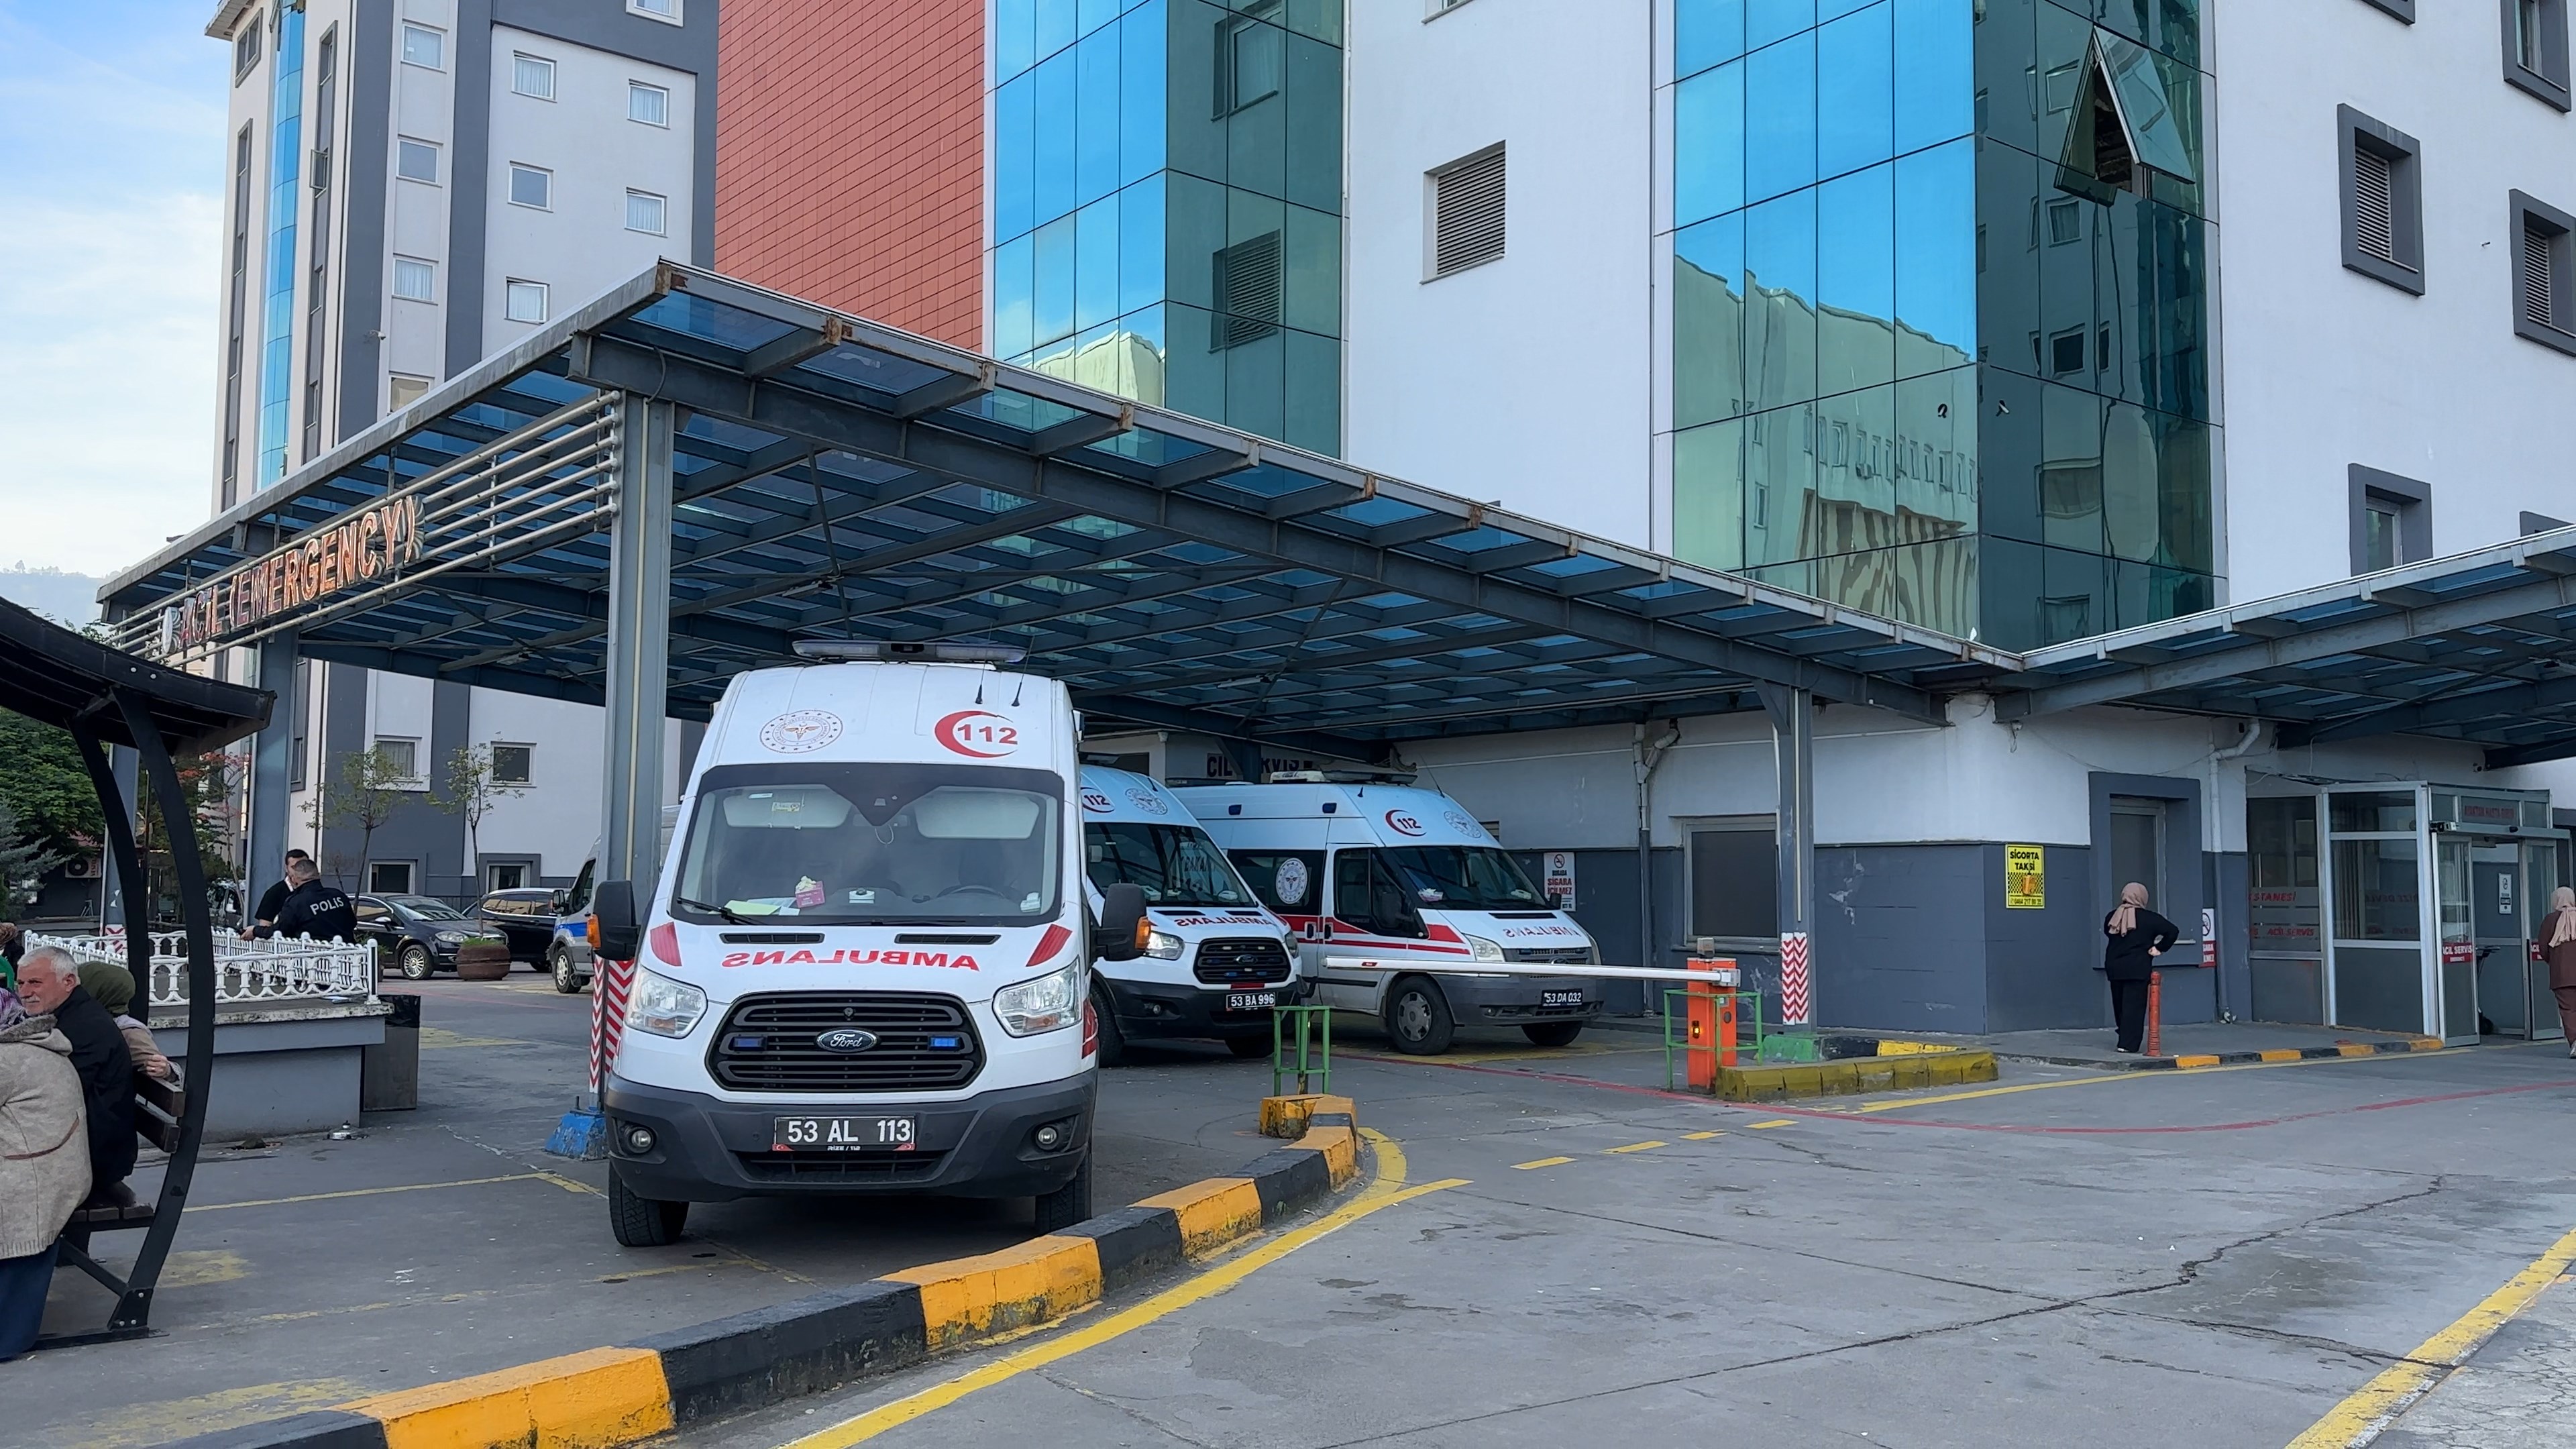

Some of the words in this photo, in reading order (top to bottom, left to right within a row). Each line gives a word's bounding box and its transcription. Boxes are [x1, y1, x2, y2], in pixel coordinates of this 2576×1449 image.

[229, 495, 416, 629] (EMERGENCY)
[957, 724, 1018, 745] 112
[1084, 795, 1110, 806] 112
[1397, 818, 1422, 829] 112
[2010, 849, 2039, 860] SİGORTA
[2015, 861, 2035, 871] TAKSİ
[1231, 996, 1243, 1007] 53
[1245, 995, 1256, 1006] BA
[1258, 994, 1274, 1004] 996
[1546, 993, 1556, 1003] 53
[1557, 993, 1566, 1003] DA
[1568, 992, 1582, 1002] 032
[830, 1033, 862, 1048] Ford
[788, 1120, 818, 1143] 53
[827, 1120, 859, 1142] AL
[877, 1120, 911, 1142] 113
